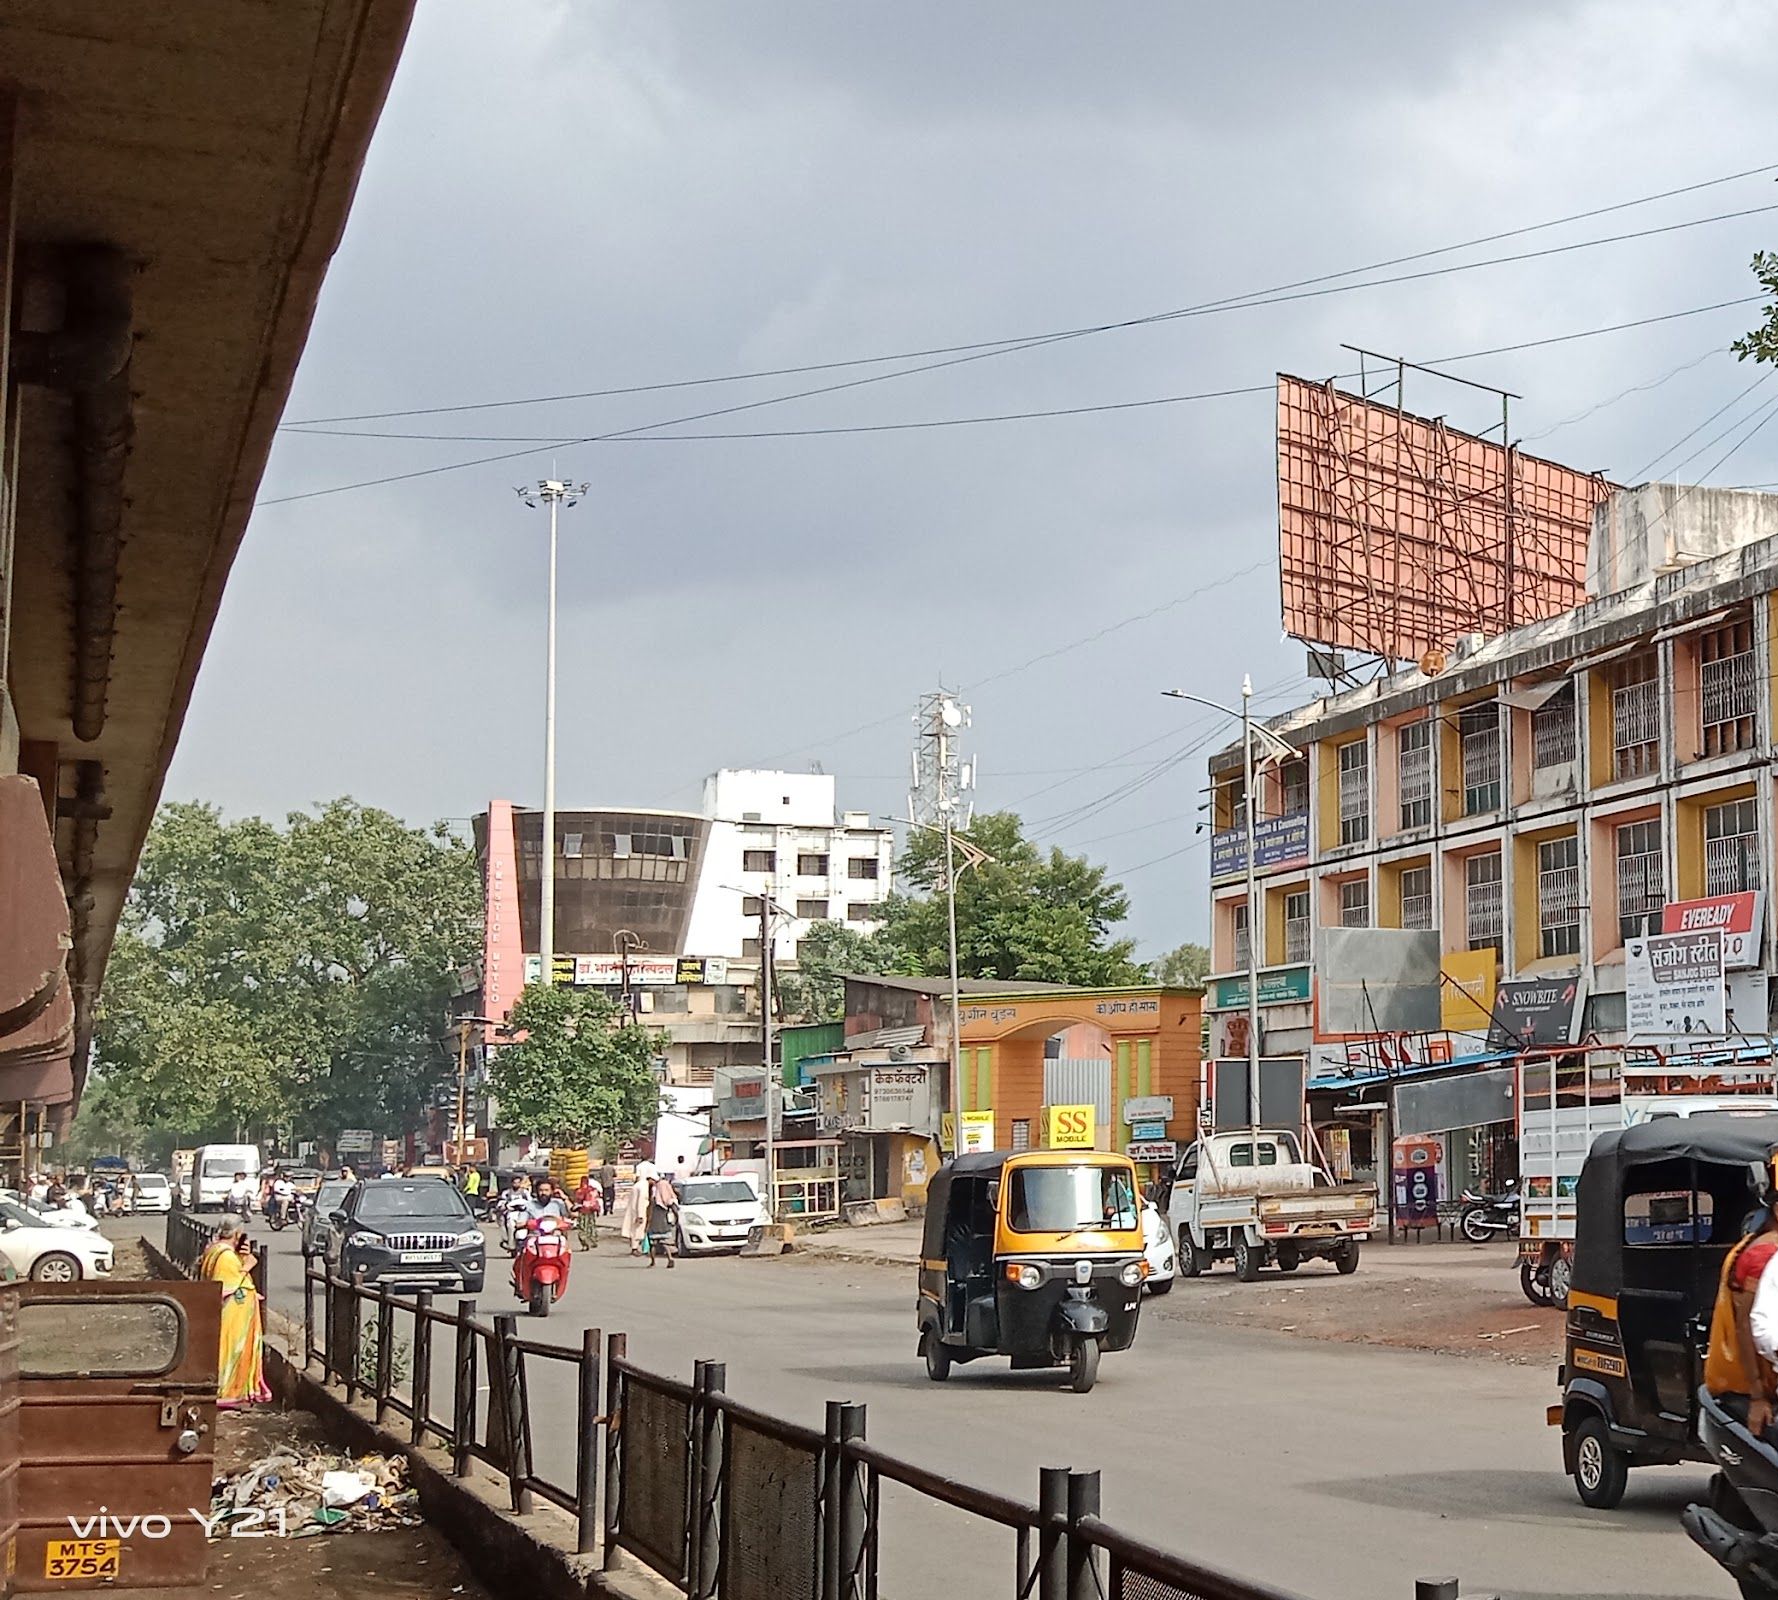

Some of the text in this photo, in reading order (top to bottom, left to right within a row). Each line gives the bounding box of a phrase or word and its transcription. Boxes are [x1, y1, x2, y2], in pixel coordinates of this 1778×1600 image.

[1680, 902, 1735, 930] EVEREADY
[1673, 967, 1699, 980] SANJOG
[1699, 965, 1720, 979] STEEL
[1512, 988, 1558, 1006] SNOWBITE
[1057, 1111, 1087, 1134] SS
[1056, 1135, 1087, 1143] MOBILE
[61, 1542, 107, 1556] MTS
[50, 1557, 117, 1577] 3754
